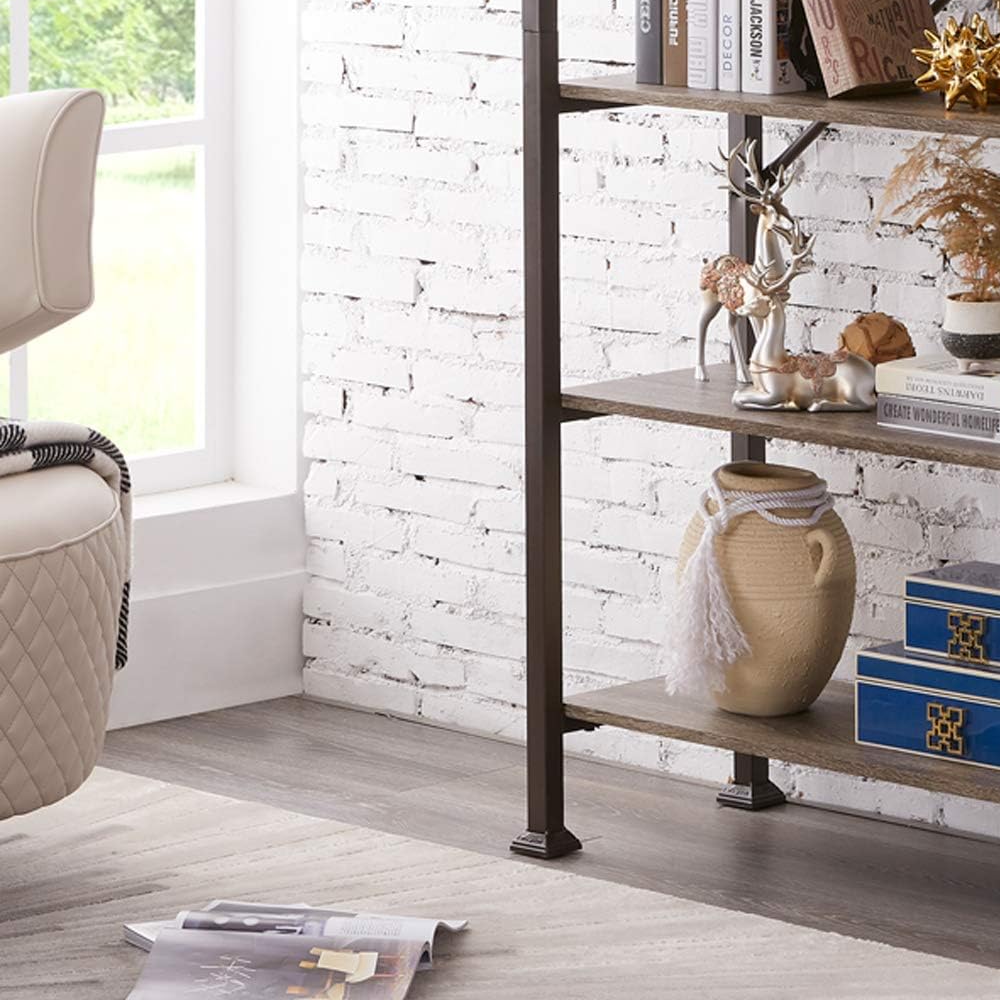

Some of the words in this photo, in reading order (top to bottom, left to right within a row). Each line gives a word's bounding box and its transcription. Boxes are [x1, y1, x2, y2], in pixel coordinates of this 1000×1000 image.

[723, 15, 733, 72] DECOR
[750, 0, 763, 58] JACKSON
[883, 402, 911, 420] CREATE
[912, 406, 960, 428] WONDERFUL
[962, 412, 1000, 434] HOMELIFE
